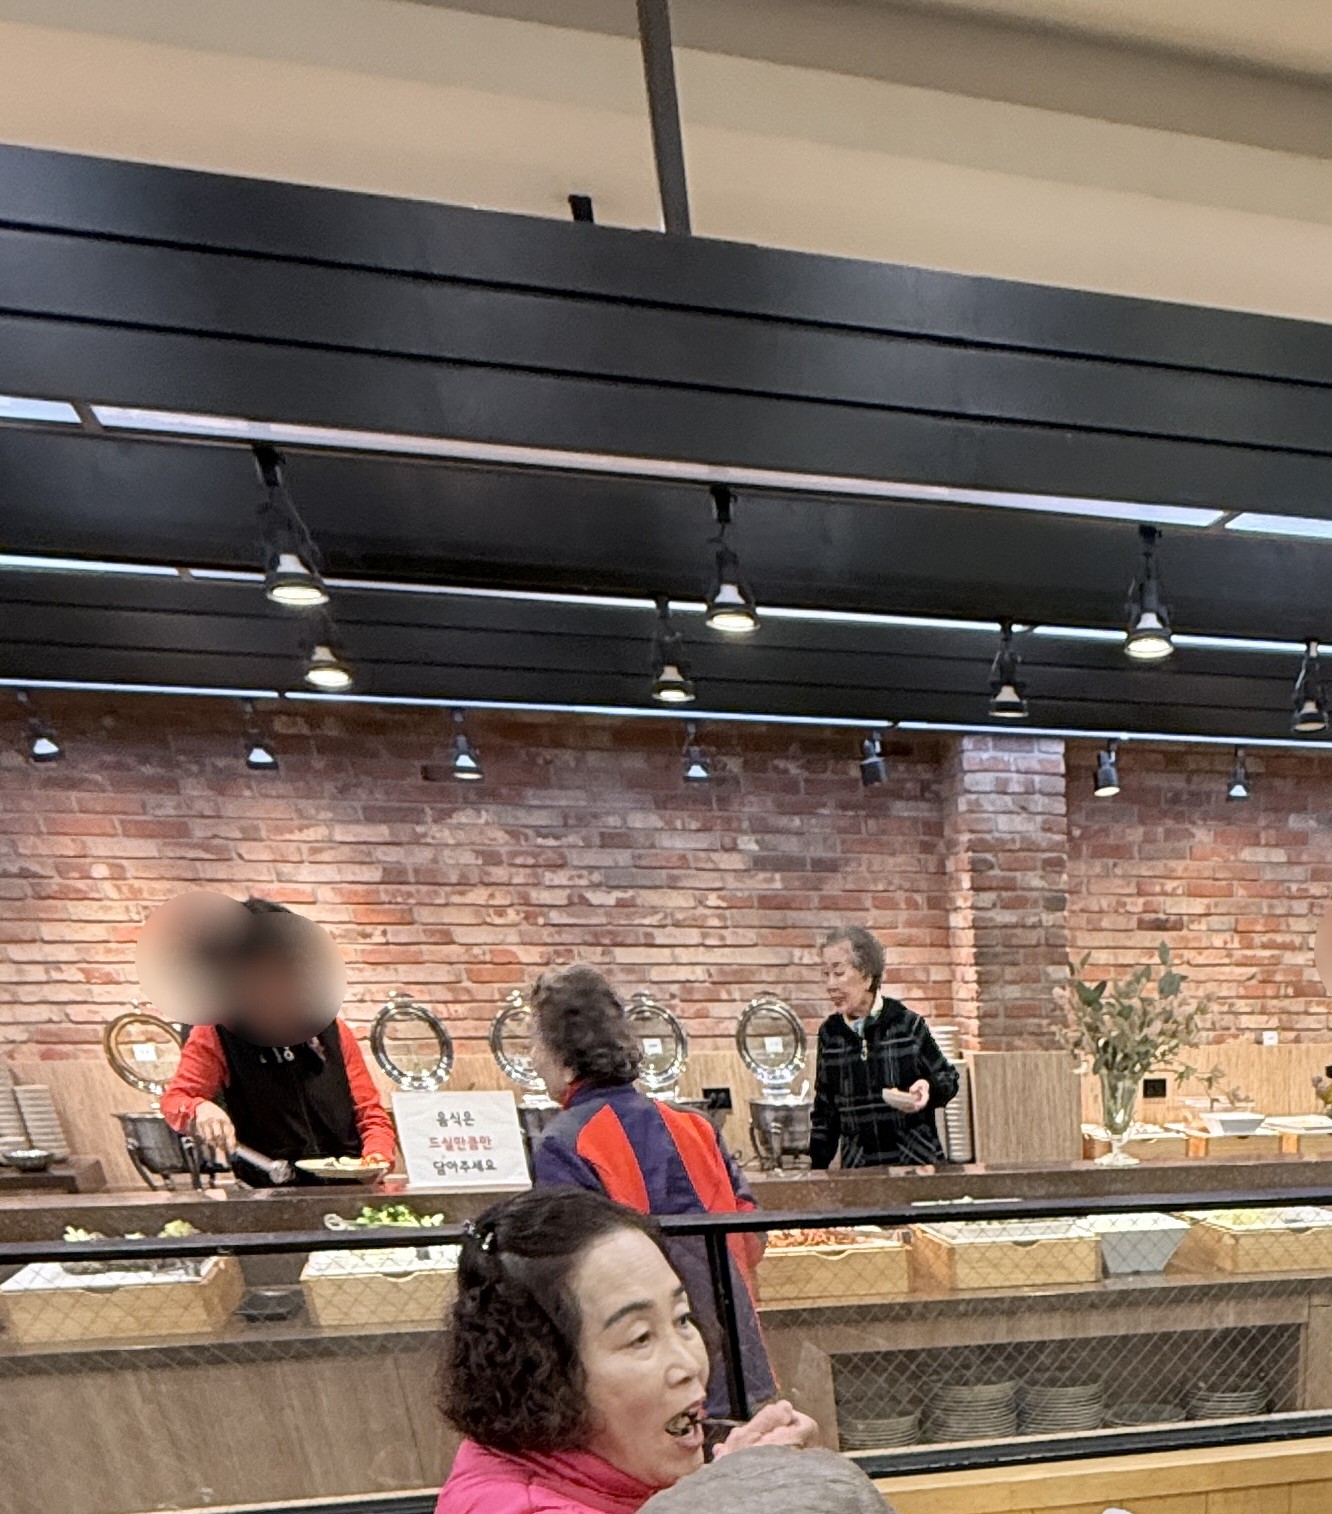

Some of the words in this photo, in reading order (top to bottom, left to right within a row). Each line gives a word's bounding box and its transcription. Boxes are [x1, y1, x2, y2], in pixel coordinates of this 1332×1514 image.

[436, 1111, 475, 1127] 음식은
[429, 1136, 492, 1151] 드실만큼만
[433, 1159, 497, 1176] 담아주세요
